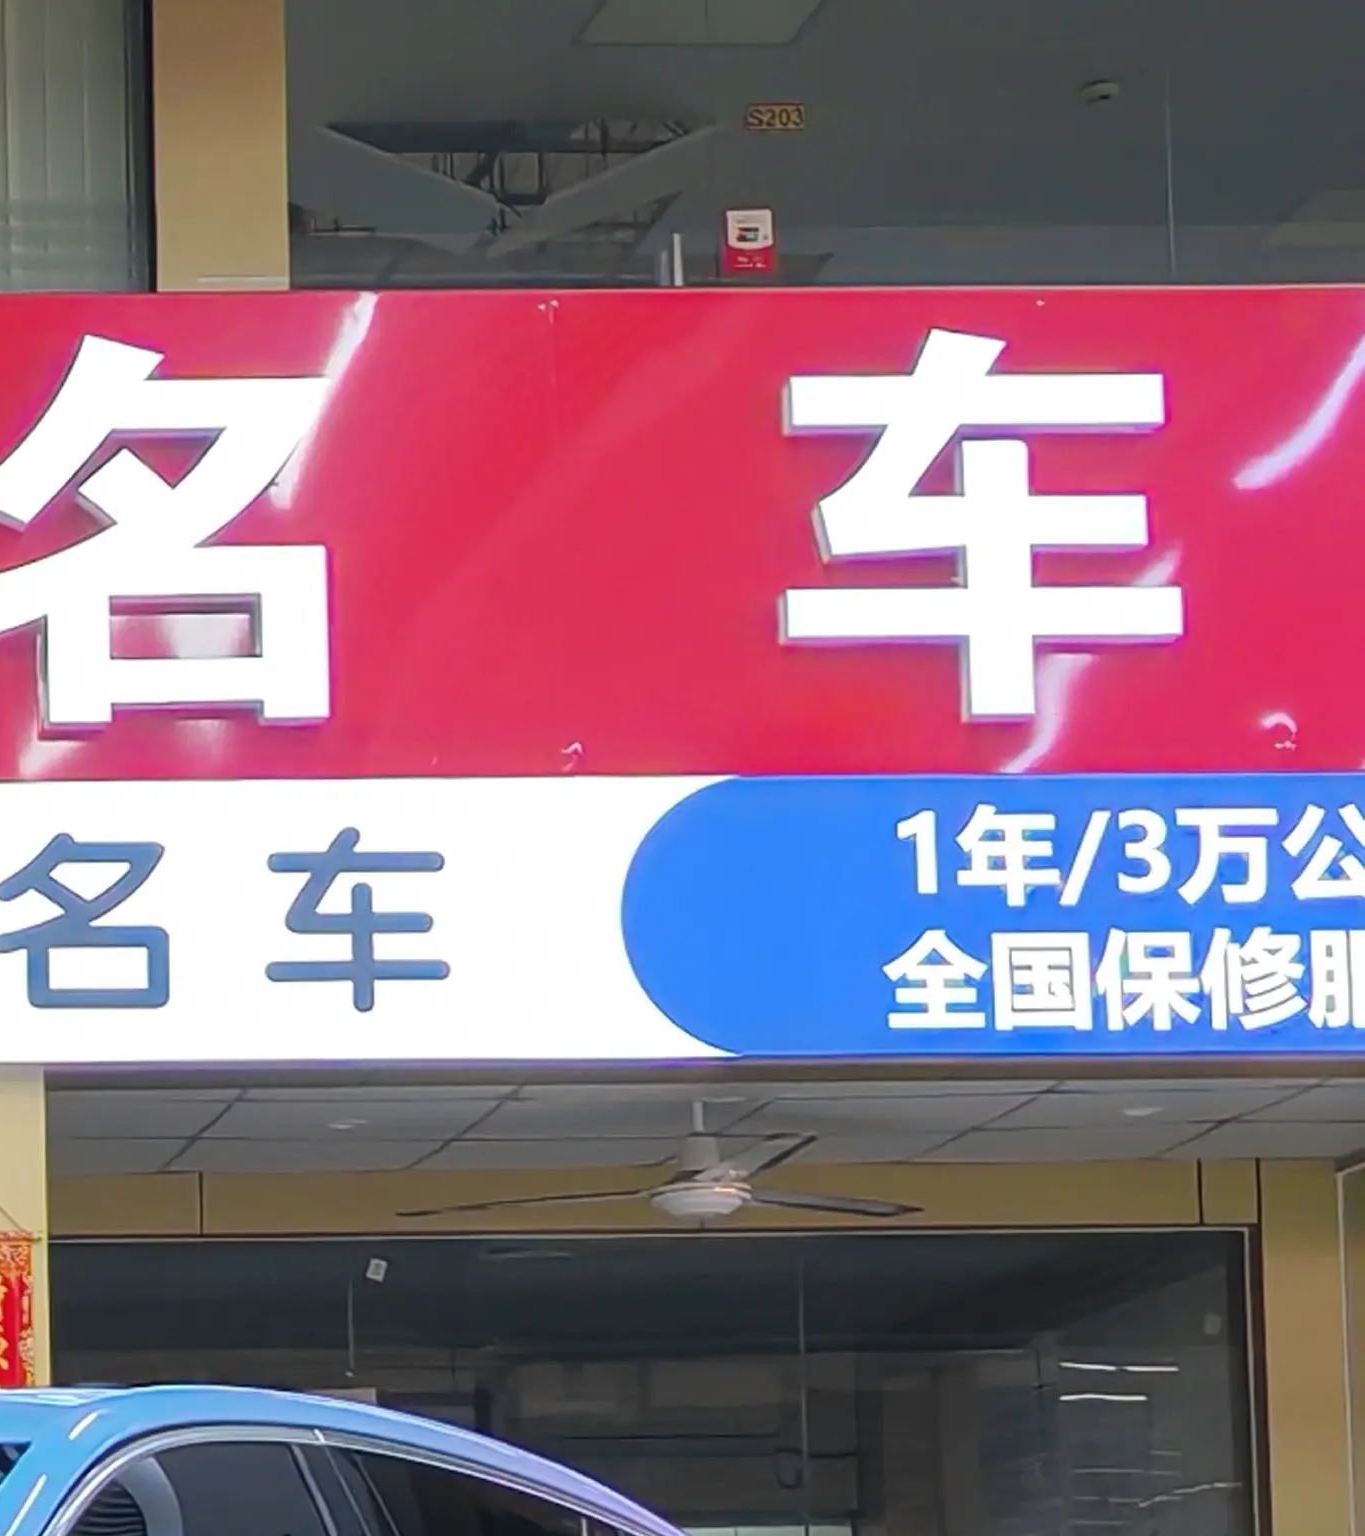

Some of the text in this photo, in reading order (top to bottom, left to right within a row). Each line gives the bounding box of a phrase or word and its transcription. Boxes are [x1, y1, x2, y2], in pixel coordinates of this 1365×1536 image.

[748, 108, 804, 127] S203
[895, 803, 1365, 906] 1年/3万公
